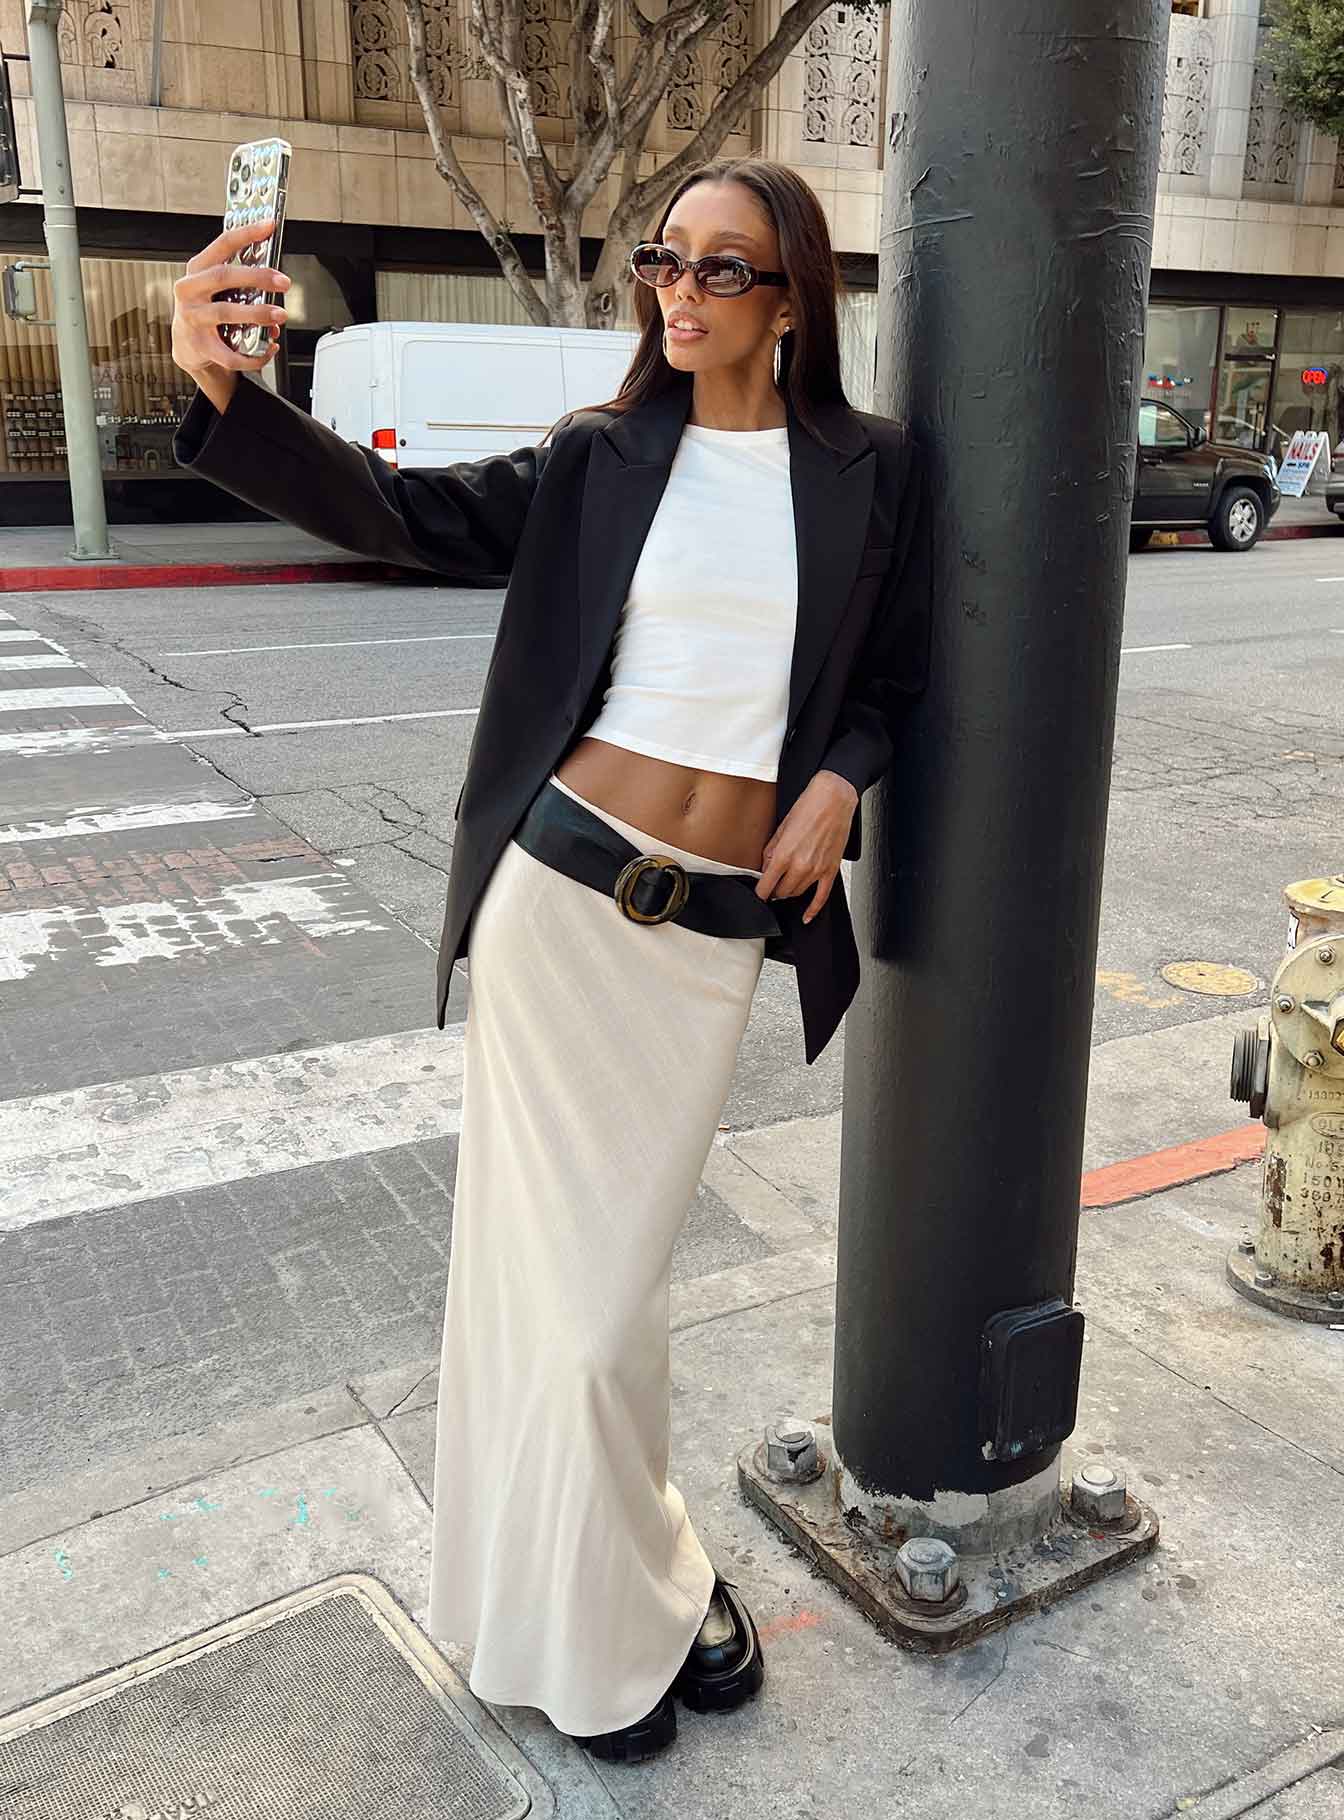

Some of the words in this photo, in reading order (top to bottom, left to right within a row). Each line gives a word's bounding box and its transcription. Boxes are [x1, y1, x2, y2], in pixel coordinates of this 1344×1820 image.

[100, 369, 158, 388] Aesop
[1302, 370, 1326, 384] OPEN
[1288, 441, 1319, 461] NAILS
